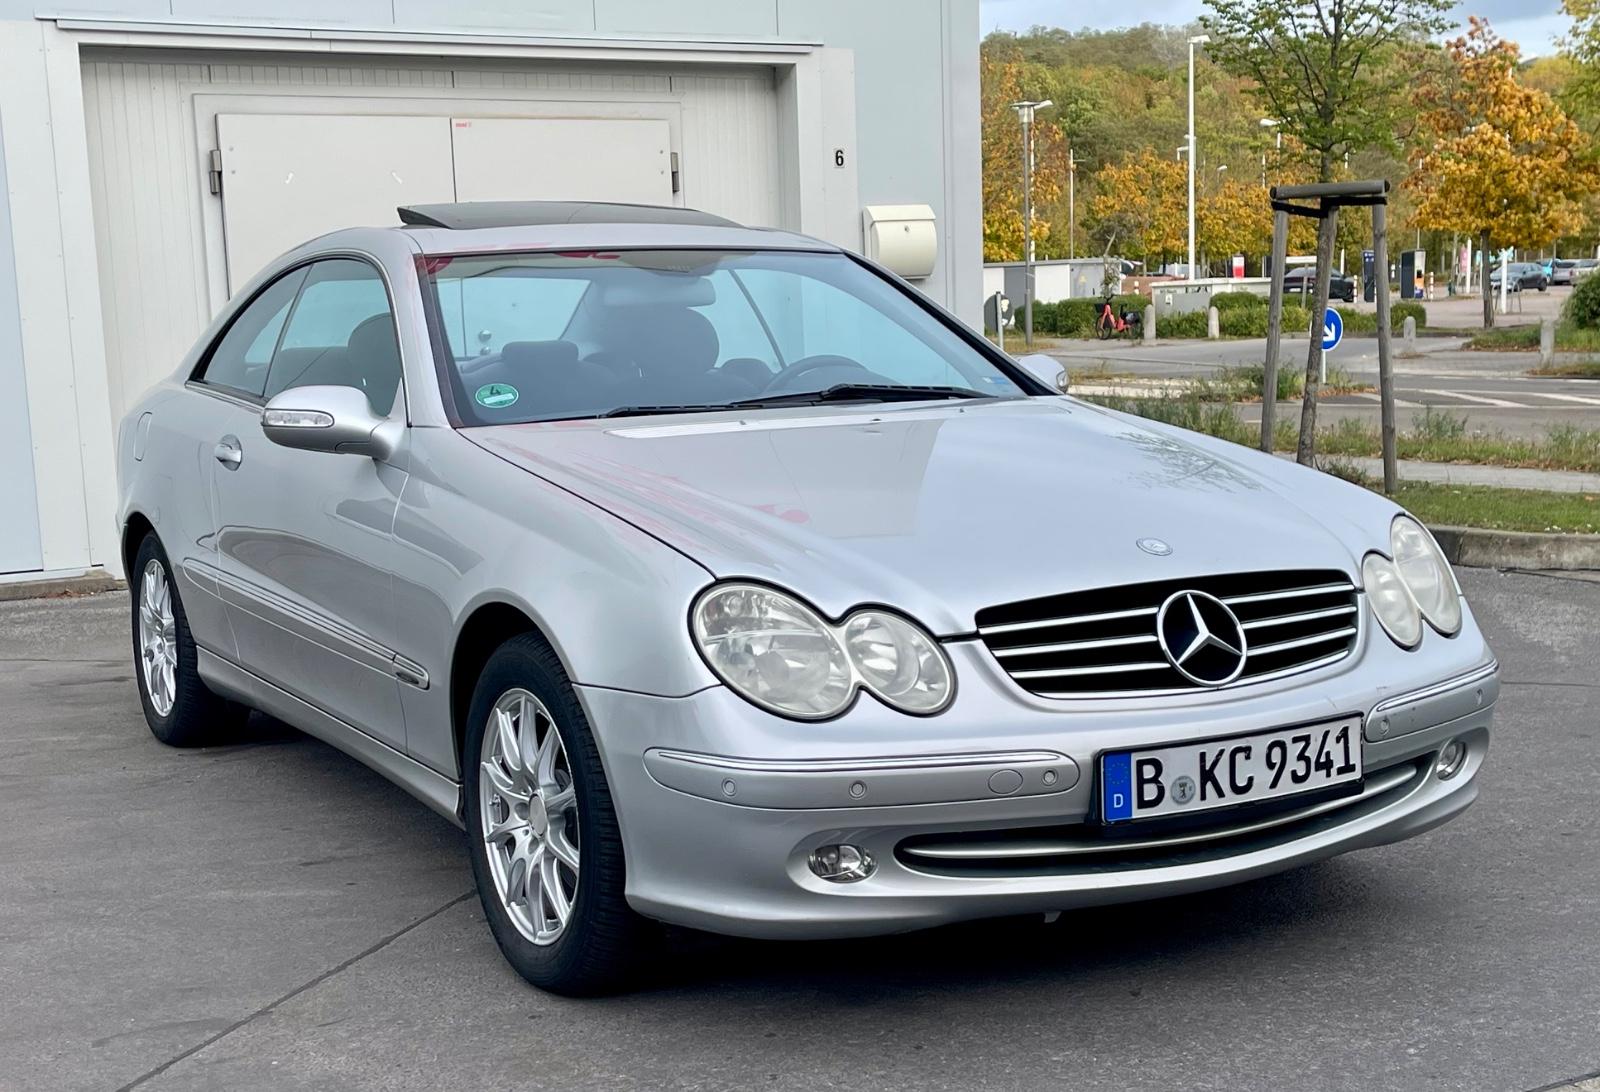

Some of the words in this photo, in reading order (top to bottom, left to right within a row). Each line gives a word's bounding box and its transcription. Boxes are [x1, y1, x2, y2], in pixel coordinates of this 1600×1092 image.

[835, 149, 844, 167] 6
[489, 385, 502, 396] 4
[1135, 757, 1166, 810] B
[1198, 745, 1255, 801] KC
[1265, 725, 1357, 790] 9341
[1113, 793, 1124, 808] D
